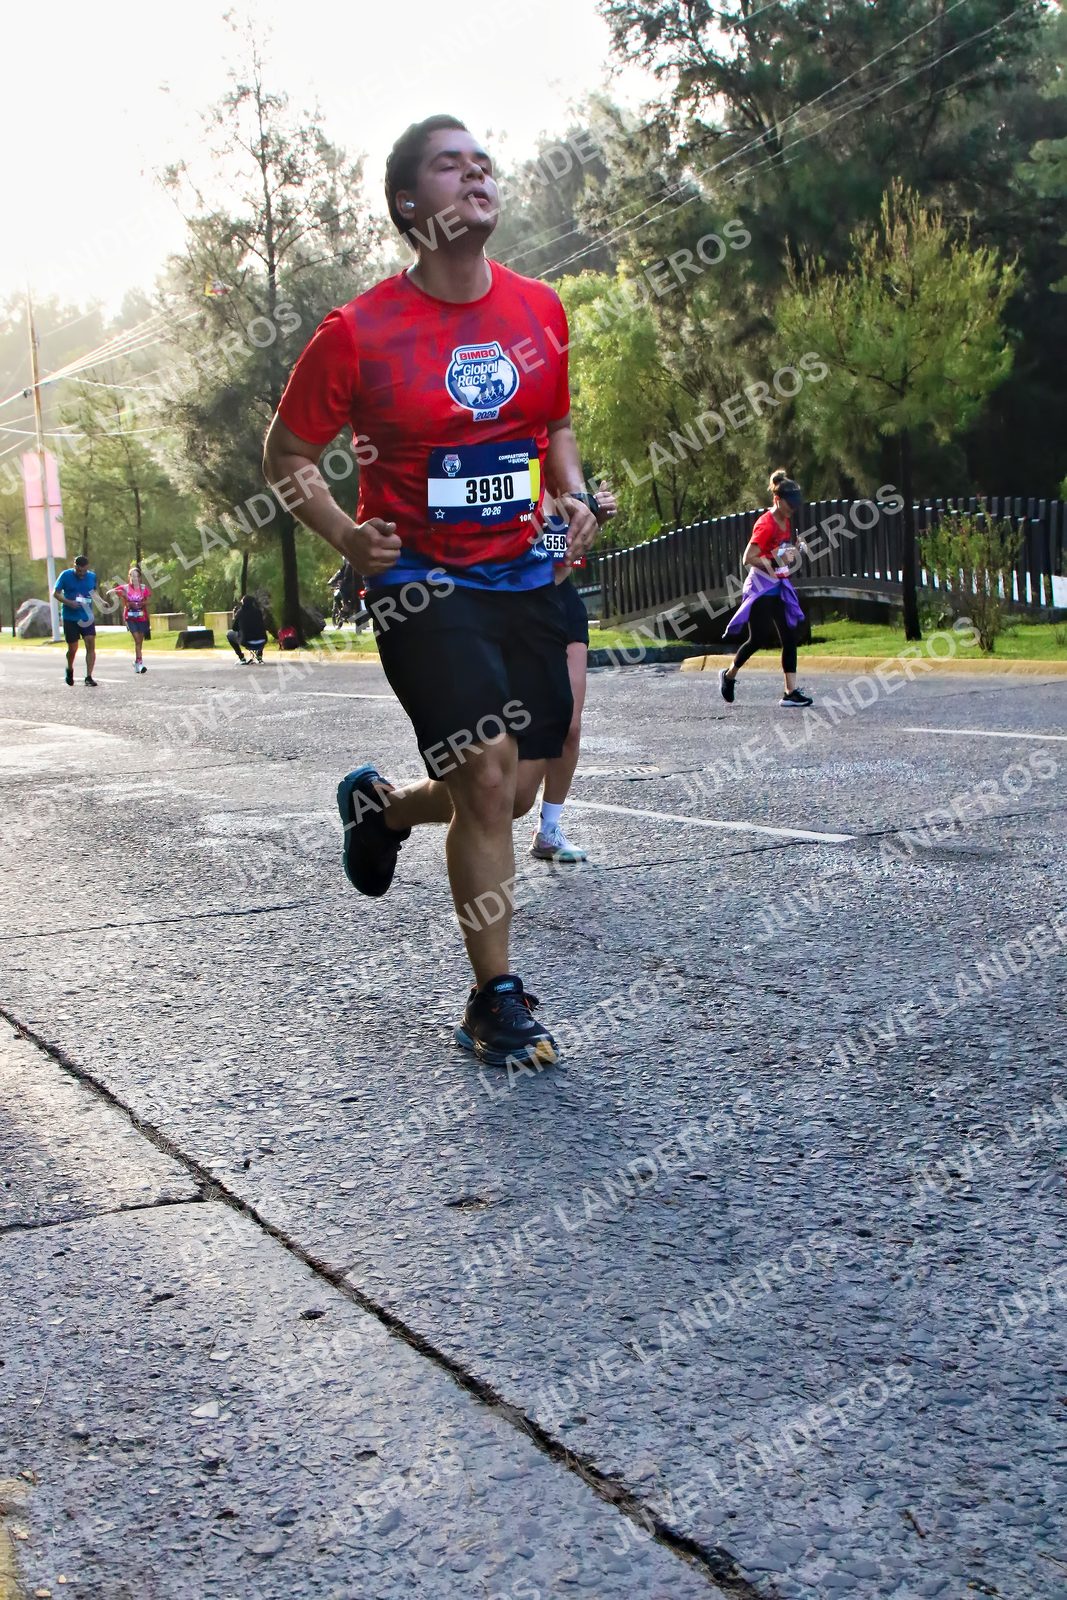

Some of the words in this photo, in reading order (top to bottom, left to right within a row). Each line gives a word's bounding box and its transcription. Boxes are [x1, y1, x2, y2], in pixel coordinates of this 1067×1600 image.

[459, 348, 497, 361] BIMBO
[463, 360, 498, 376] Global
[457, 374, 487, 388] Race
[475, 410, 498, 421] 2026
[465, 475, 514, 504] 3930
[546, 535, 568, 550] 559
